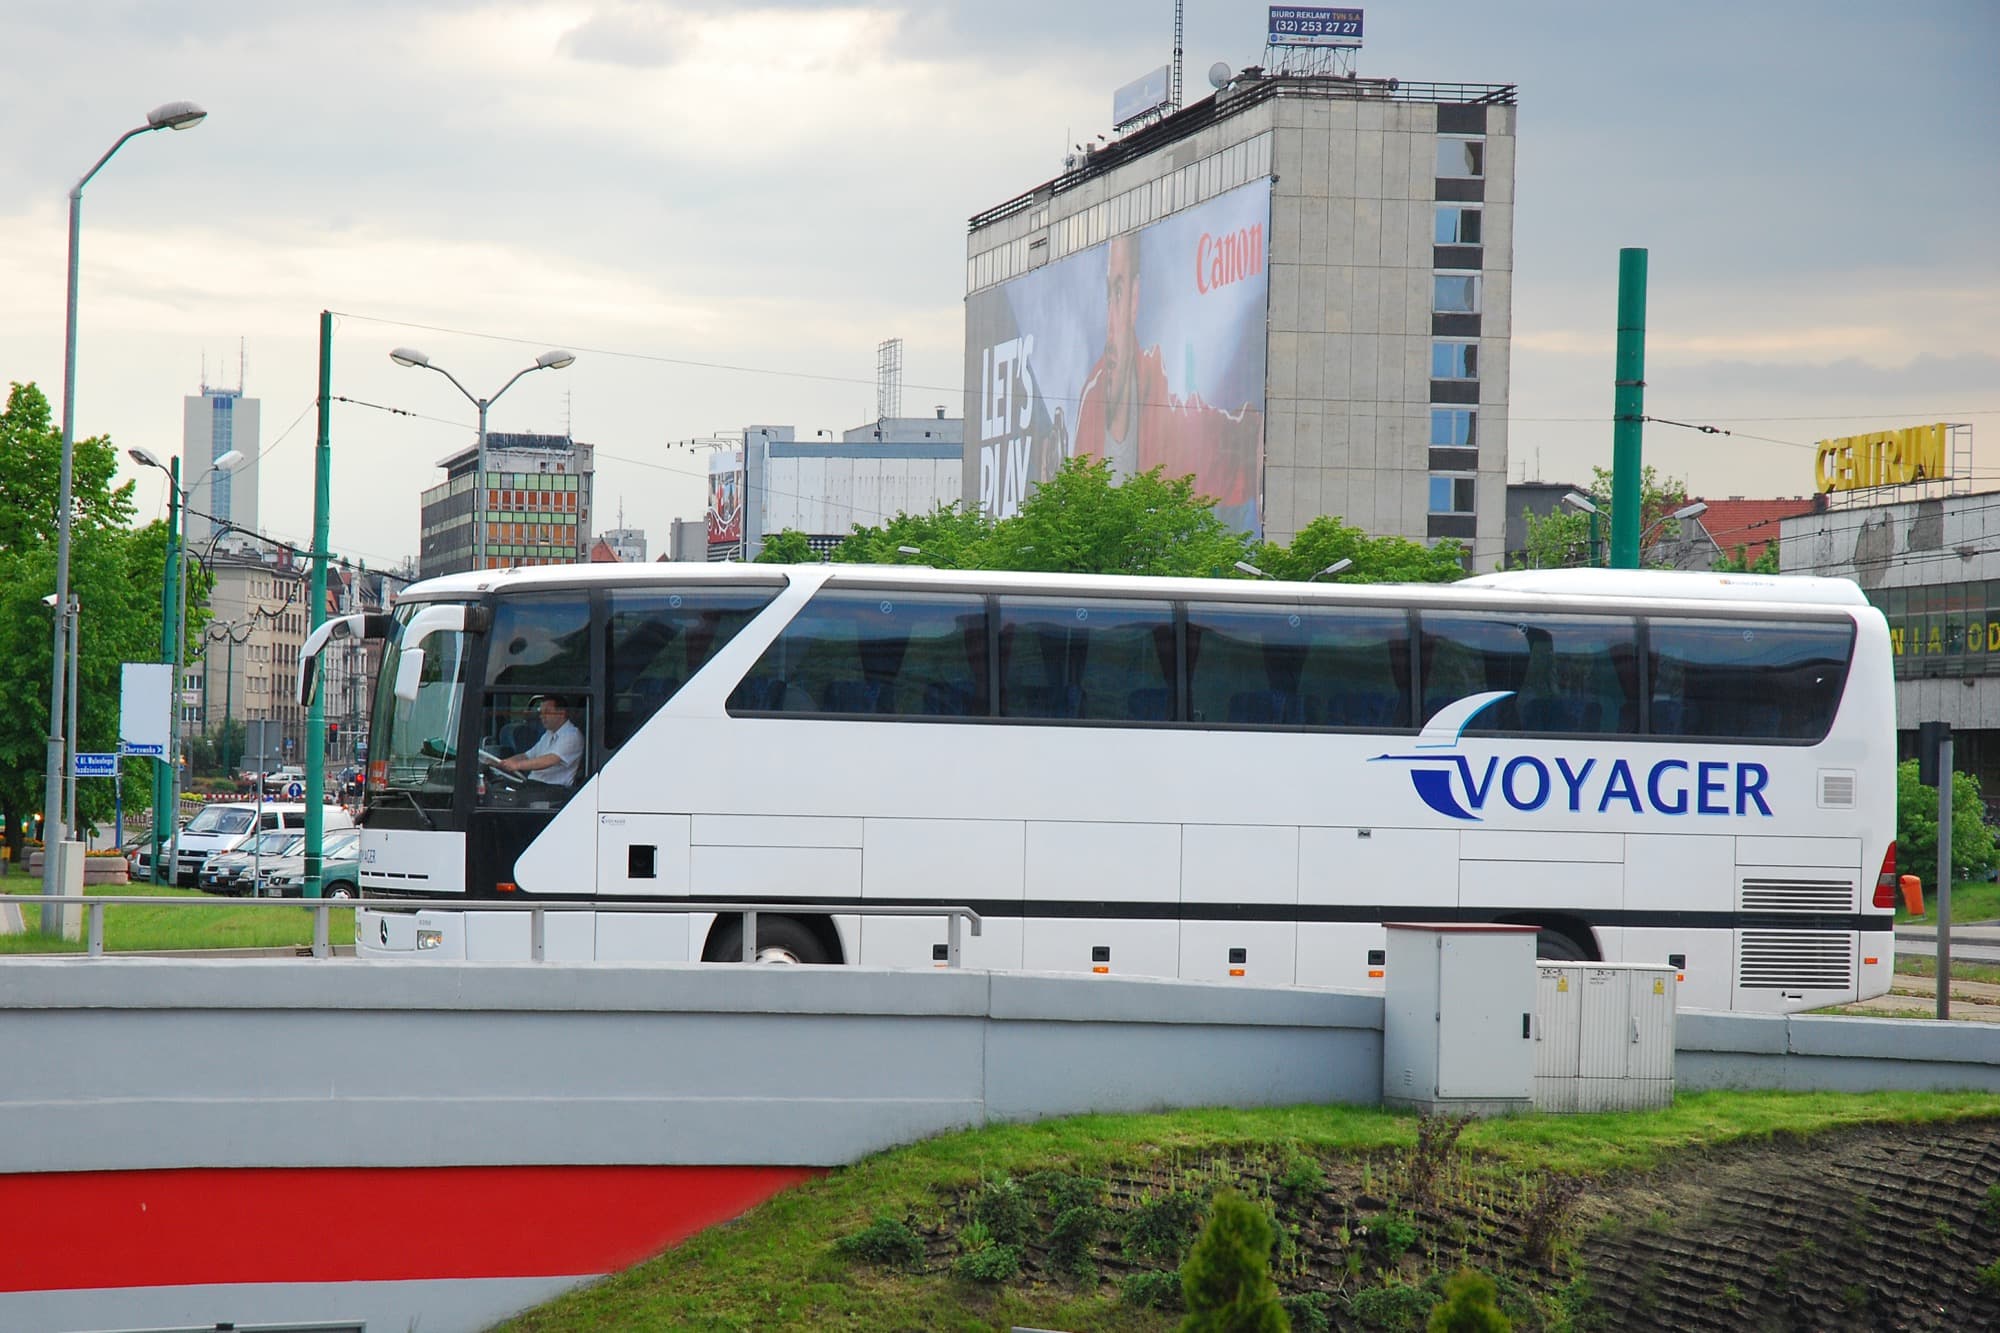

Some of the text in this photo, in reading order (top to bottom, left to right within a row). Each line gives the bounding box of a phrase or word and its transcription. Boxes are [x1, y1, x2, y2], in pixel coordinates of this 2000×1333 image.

[1271, 10, 1295, 18] BIURO
[1296, 11, 1331, 20] REKLAMY
[1275, 20, 1357, 33] (32) 253 27 27
[1196, 222, 1263, 295] Canon
[981, 333, 1034, 441] LET'S
[979, 436, 1032, 519] PLAY
[1815, 423, 1946, 494] CENTRUM
[1455, 754, 1774, 816] VOYAGER
